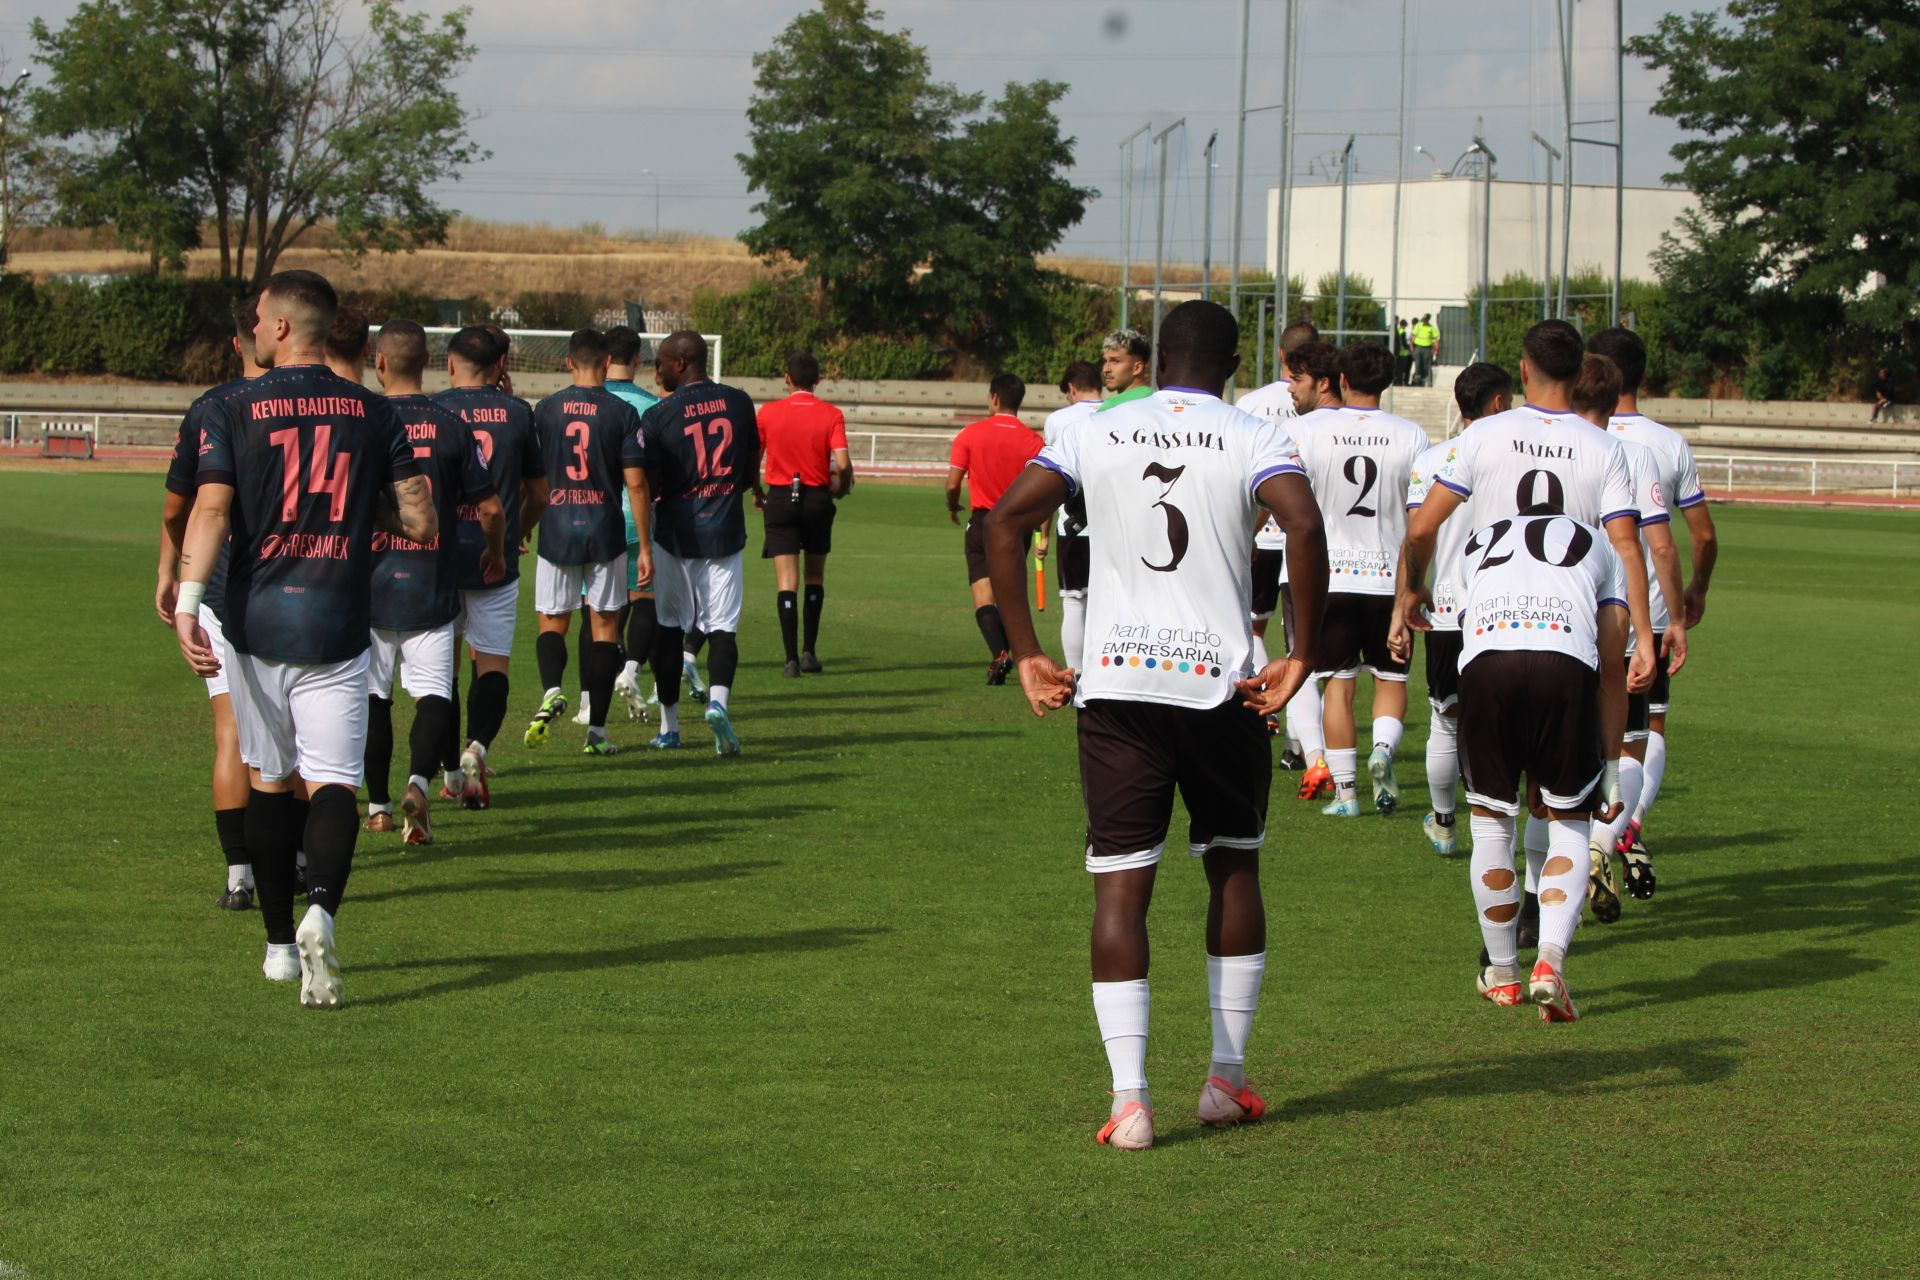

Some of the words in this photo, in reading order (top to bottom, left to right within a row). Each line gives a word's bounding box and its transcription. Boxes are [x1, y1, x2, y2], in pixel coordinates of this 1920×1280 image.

[251, 398, 294, 420] KEVIN
[299, 397, 365, 418] BAUTISTA
[473, 408, 507, 423] SOLER
[563, 400, 598, 416] VÍCTOR
[684, 405, 697, 418] JC
[698, 399, 726, 415] BABIN
[565, 421, 590, 481] 3
[684, 417, 733, 480] 12
[1107, 430, 1126, 446] S.
[1132, 428, 1224, 451] GASSAMA
[1333, 435, 1390, 447] YAGUITO
[1511, 439, 1576, 461] MAIKEL
[270, 425, 351, 522] 14
[1343, 455, 1378, 518] 2
[1141, 461, 1189, 572] 3
[282, 534, 349, 560] FRESAMEX
[1464, 517, 1593, 577] 20
[1475, 592, 1511, 616] nani
[1517, 593, 1573, 614] grupo
[1108, 624, 1150, 640] nani
[1157, 627, 1222, 648] grupo
[1102, 642, 1223, 666] EMPRESARIAL
